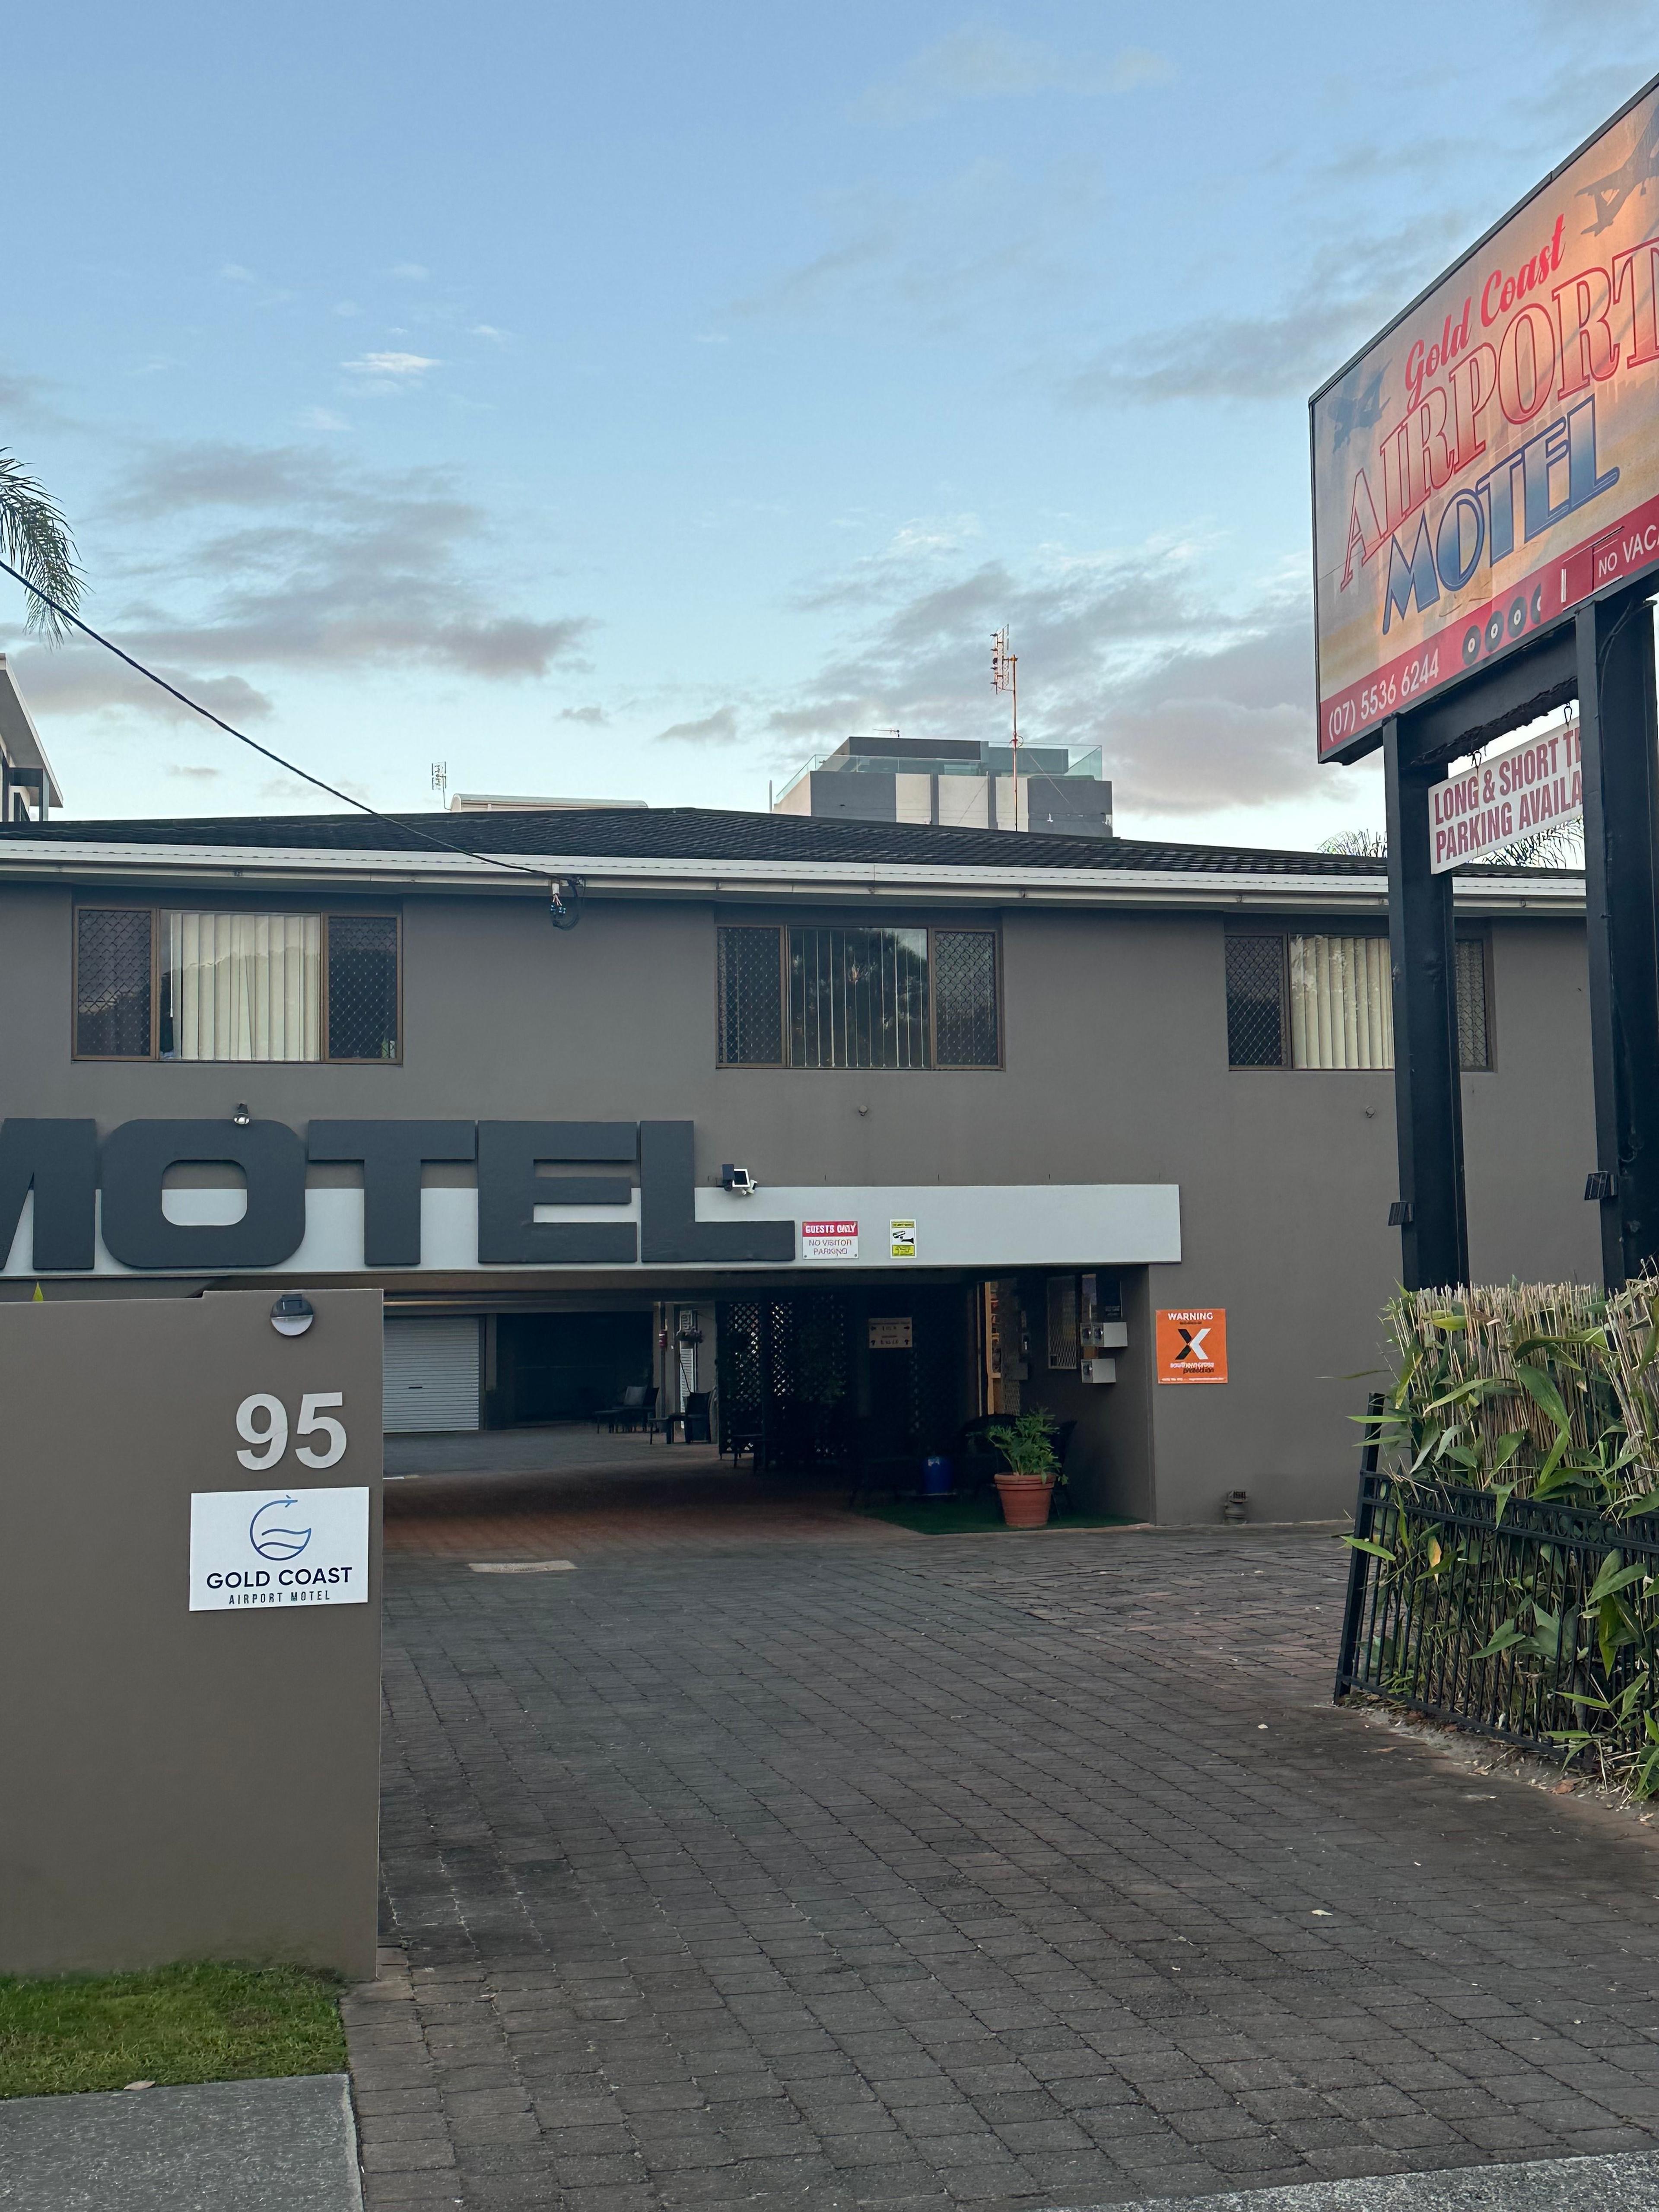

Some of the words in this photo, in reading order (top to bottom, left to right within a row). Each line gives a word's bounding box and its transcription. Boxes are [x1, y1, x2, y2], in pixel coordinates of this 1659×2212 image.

[1405, 296, 1472, 414] Gold
[1481, 213, 1566, 327] Coast
[1341, 236, 1659, 592] AIRPORT
[1383, 394, 1620, 635] MOTEL
[1599, 552, 1618, 578] NO
[1623, 524, 1659, 563] VAC
[1329, 699, 1356, 742] (07)
[1361, 674, 1396, 720] 5536
[1401, 648, 1439, 696] 6244
[1435, 776, 1479, 826] LONG
[1483, 769, 1496, 804] &
[1500, 737, 1558, 796] SHORT
[1436, 802, 1513, 864] PARKING
[805, 1225, 835, 1233] GUESTS
[837, 1224, 856, 1233] ONLY
[1168, 1312, 1213, 1321] WARNING
[235, 1392, 347, 1471] 95
[207, 1570, 270, 1589] GOLD
[278, 1567, 353, 1586] COAST
[229, 1592, 283, 1605] AIRPORT
[290, 1590, 330, 1602] MOTEL
